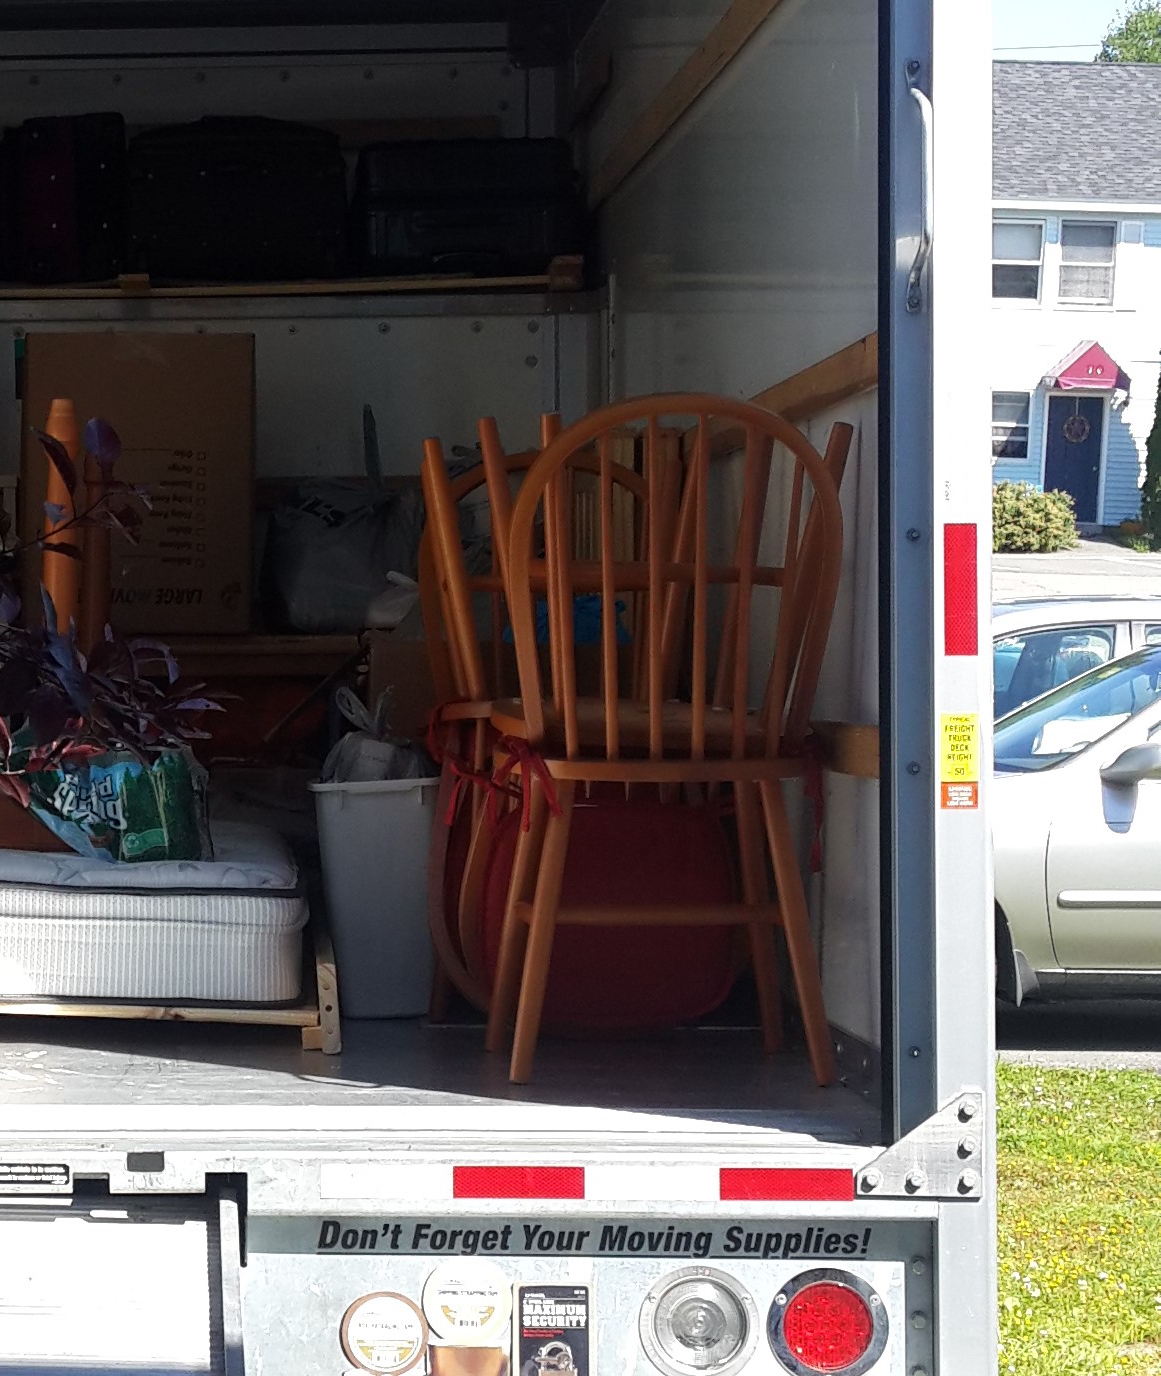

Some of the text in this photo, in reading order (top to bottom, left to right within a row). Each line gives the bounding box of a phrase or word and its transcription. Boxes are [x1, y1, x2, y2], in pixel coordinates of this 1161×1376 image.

[155, 588, 203, 605] LARGE
[948, 734, 972, 742] TRUCK
[317, 1220, 872, 1259] Don't Forget Your Moving Supplies!
[522, 1304, 587, 1316] MAXIMUM
[522, 1315, 587, 1327] SECURITY
